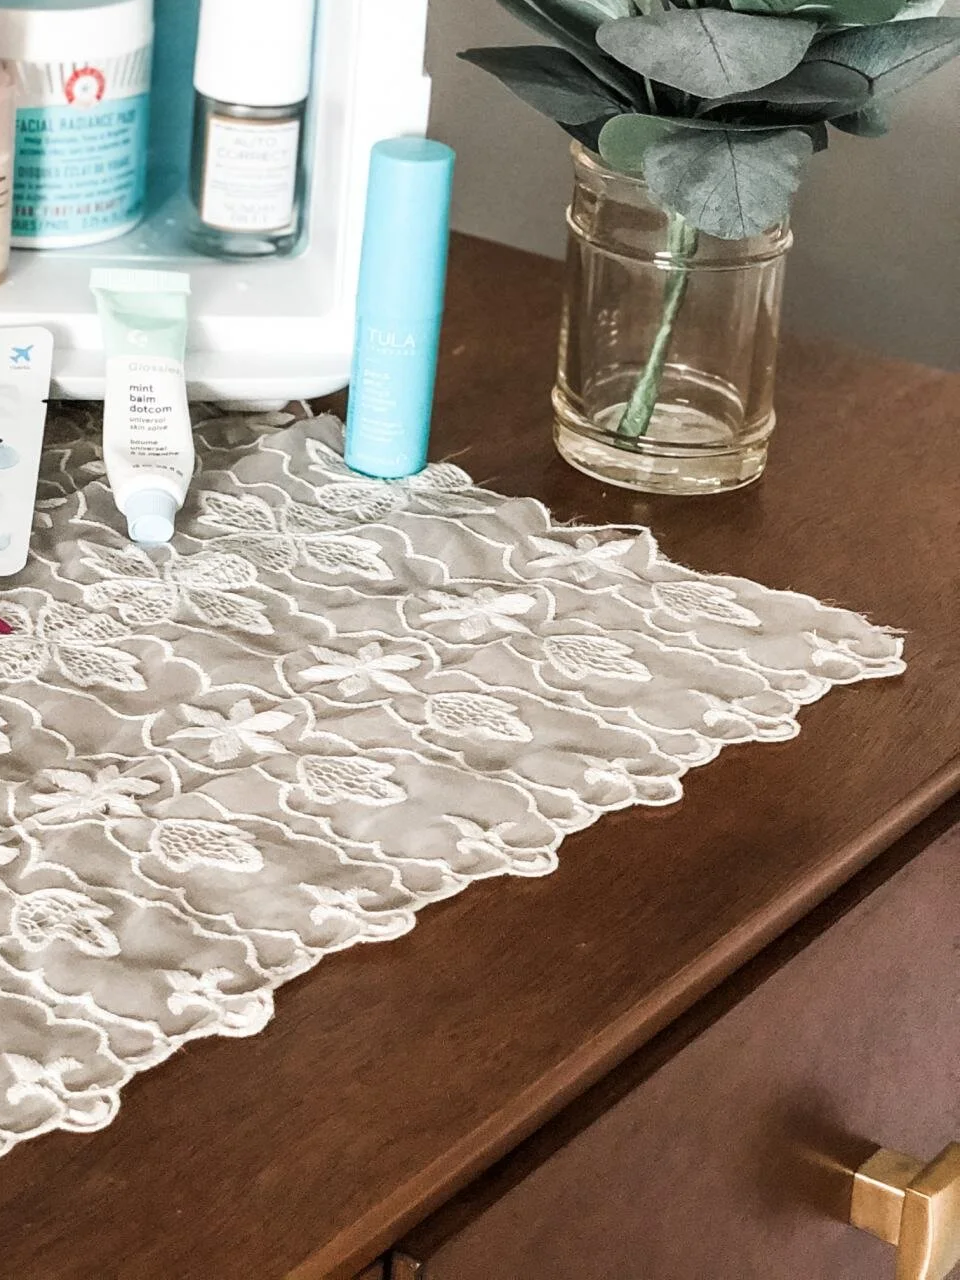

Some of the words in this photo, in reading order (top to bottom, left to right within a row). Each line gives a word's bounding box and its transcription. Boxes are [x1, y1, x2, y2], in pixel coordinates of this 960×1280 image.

[368, 326, 416, 348] TULA
[129, 384, 153, 393] mint
[129, 394, 156, 404] balm
[129, 405, 172, 414] dotcom
